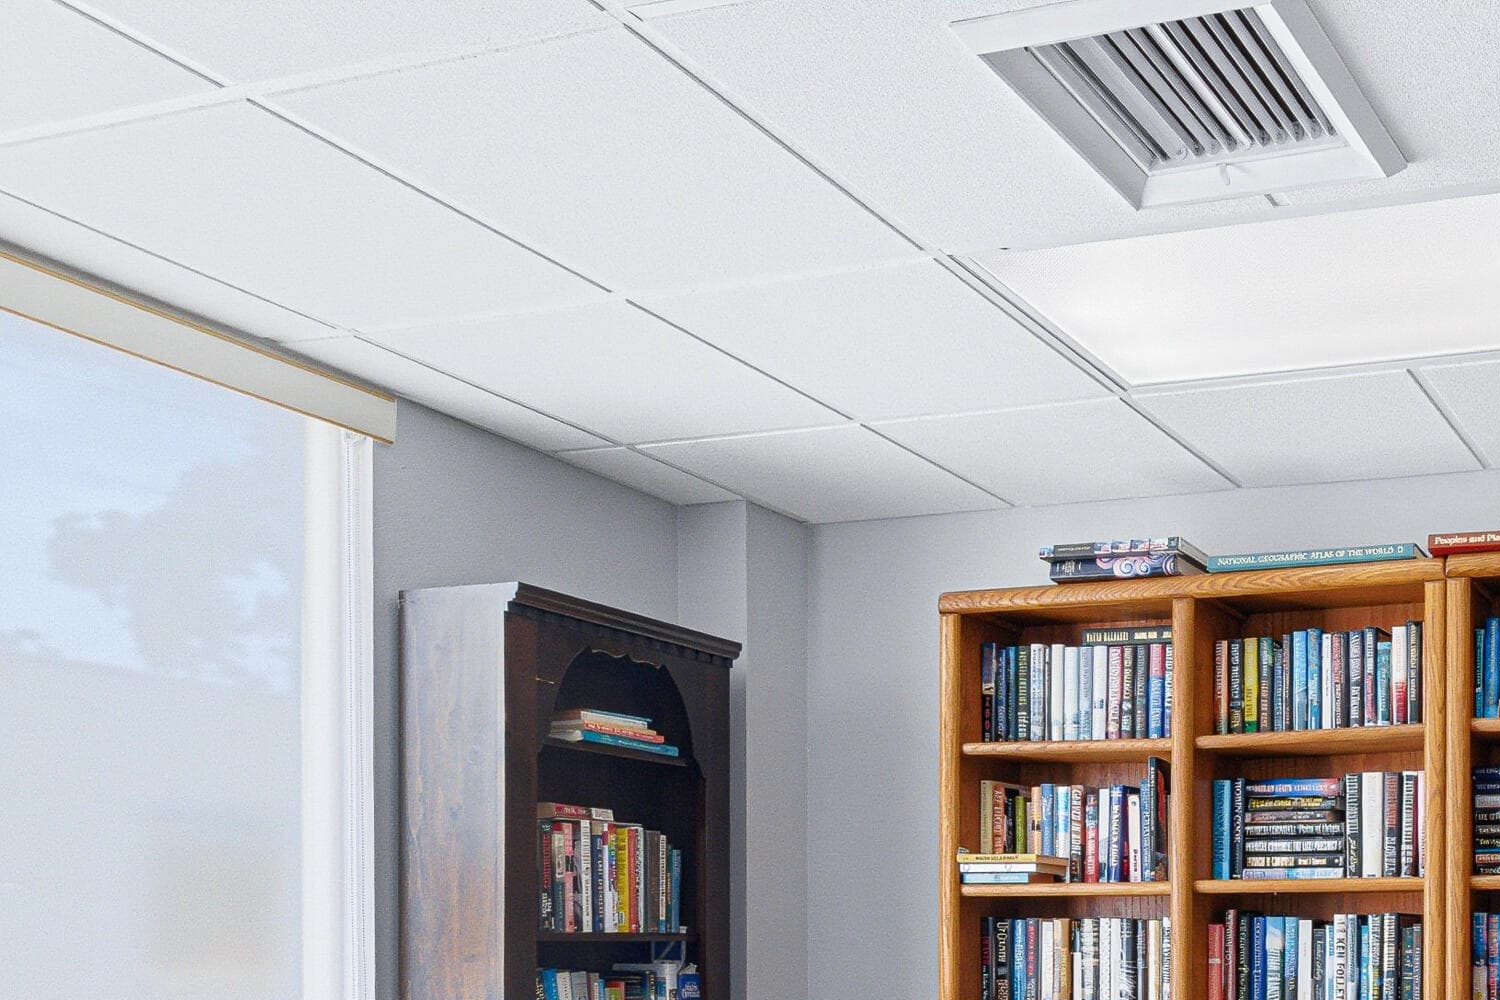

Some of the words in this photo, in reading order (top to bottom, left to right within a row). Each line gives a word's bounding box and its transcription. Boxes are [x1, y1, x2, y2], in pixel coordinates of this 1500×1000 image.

[1435, 536, 1467, 546] Peoples
[1469, 534, 1485, 543] and
[1217, 555, 1257, 566] NATIONAL
[1258, 552, 1307, 564] GEOGRAPHIC
[1311, 551, 1332, 559] ATLAS
[1335, 549, 1344, 558] OF
[1347, 548, 1363, 557] THE
[1365, 545, 1394, 556] WORLD
